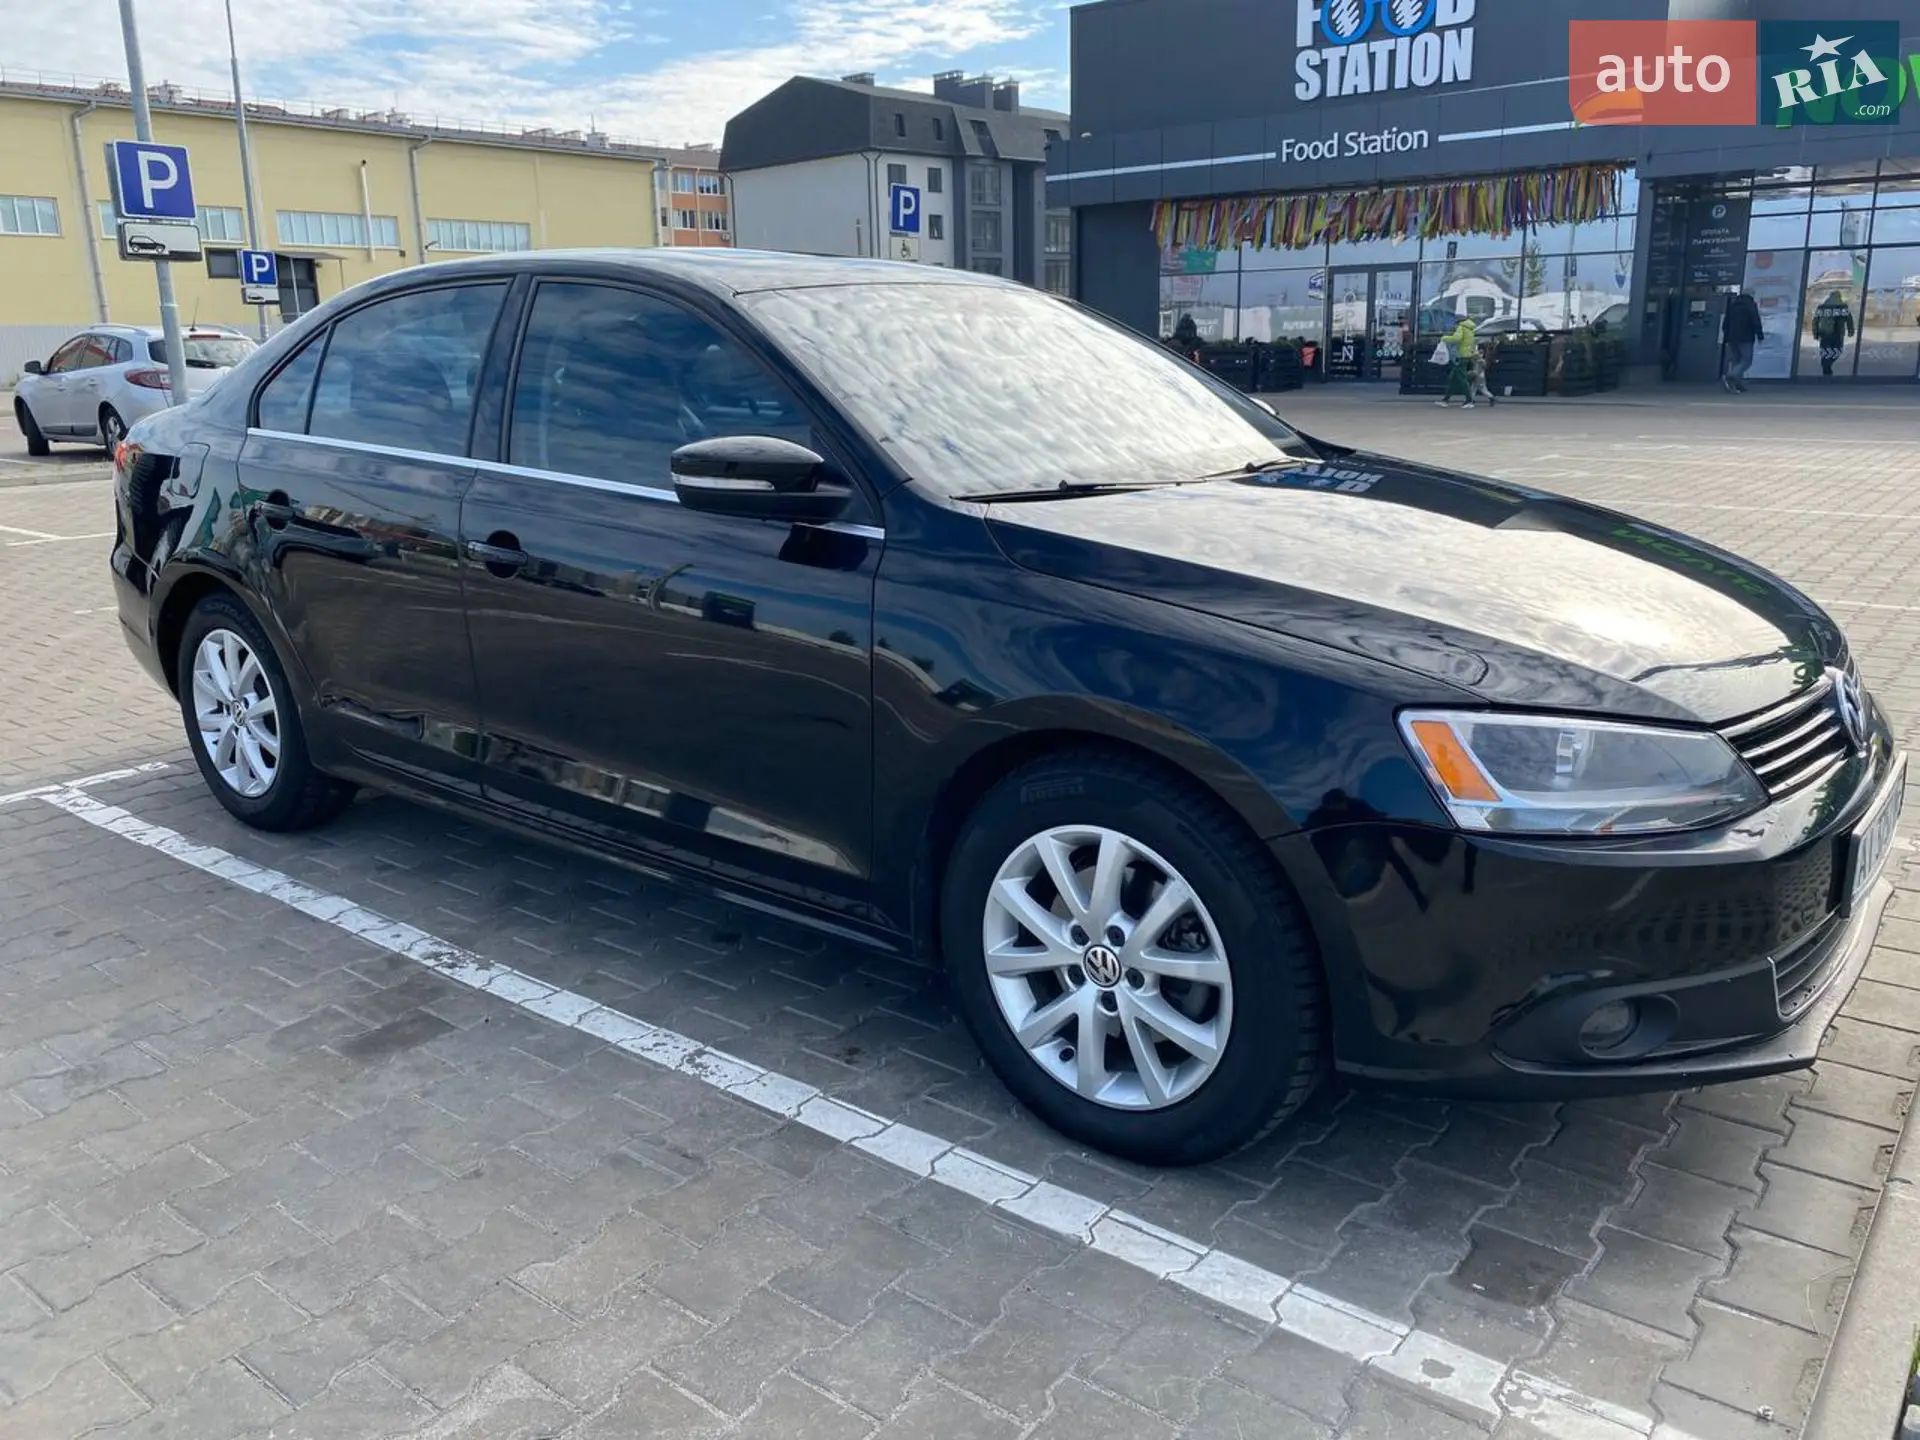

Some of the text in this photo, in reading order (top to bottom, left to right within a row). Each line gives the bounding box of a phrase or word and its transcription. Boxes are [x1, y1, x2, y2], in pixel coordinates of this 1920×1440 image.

[1295, 27, 1474, 100] STATION
[1775, 53, 1920, 129] NO
[1281, 127, 1429, 163] Food Station
[137, 150, 178, 209] P
[899, 189, 916, 227] P
[251, 254, 270, 281] P
